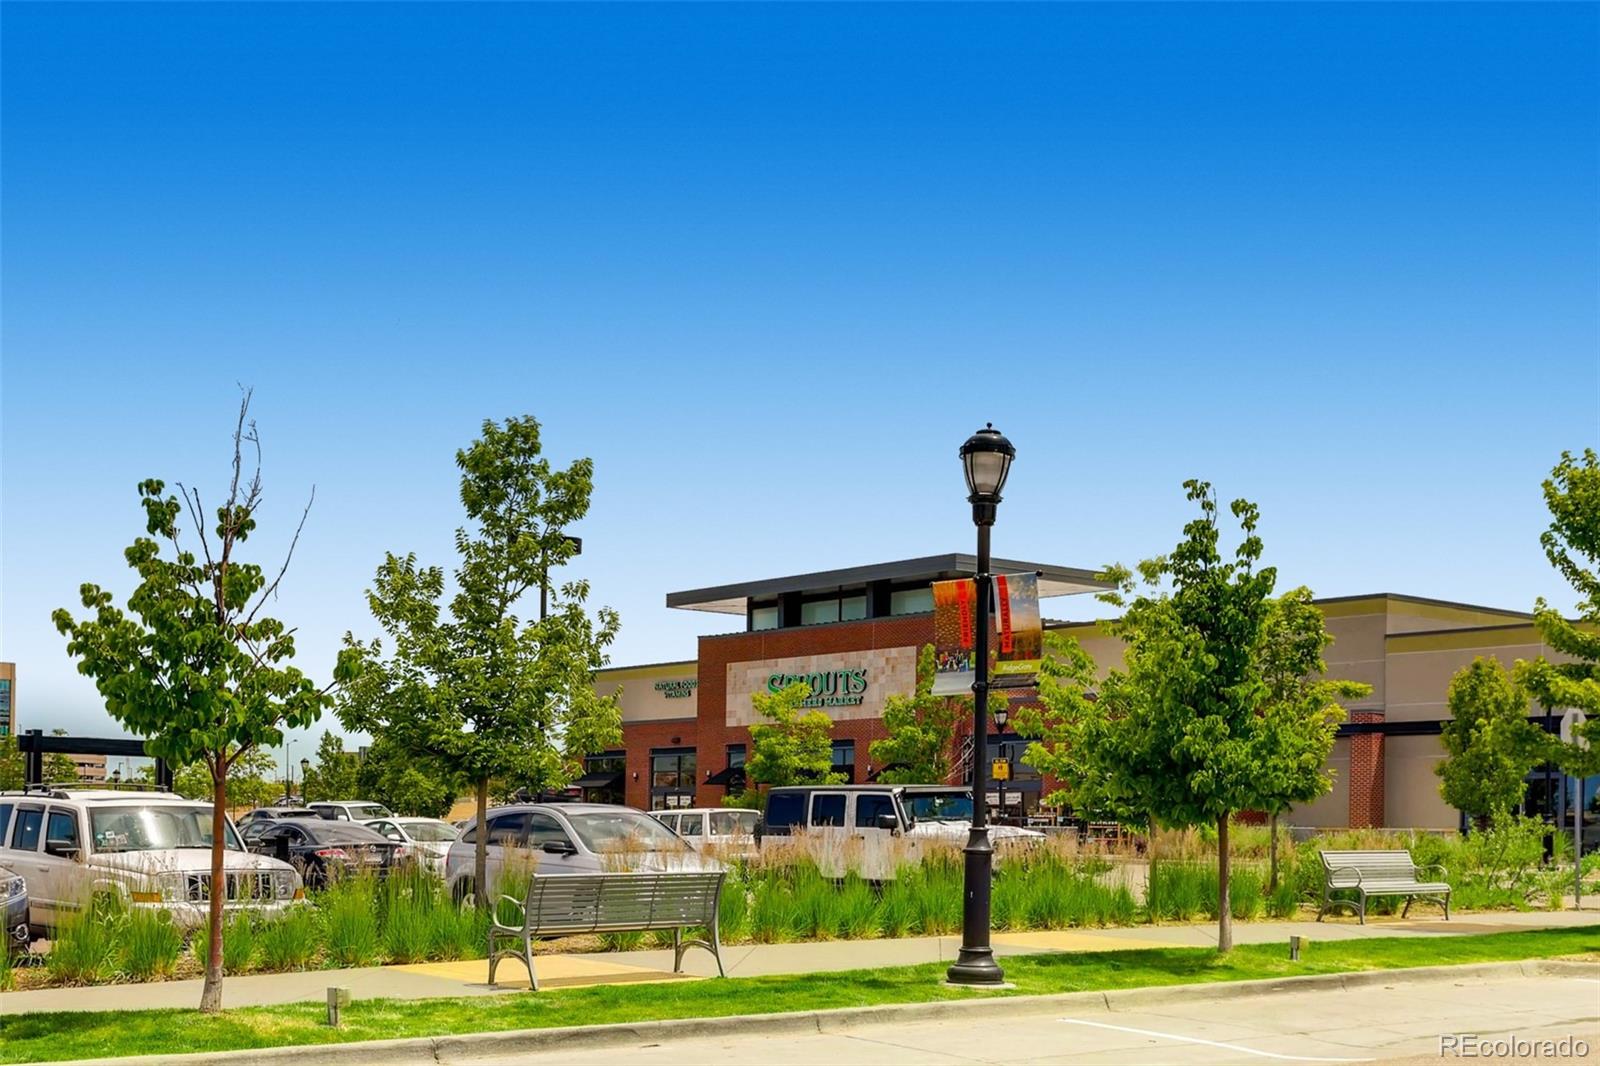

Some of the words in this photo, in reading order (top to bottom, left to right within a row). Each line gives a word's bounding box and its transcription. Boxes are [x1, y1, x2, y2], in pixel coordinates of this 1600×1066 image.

[960, 600, 969, 643] FRIENDLY
[1000, 598, 1010, 649] NATURALLY
[827, 696, 864, 707] MARKET
